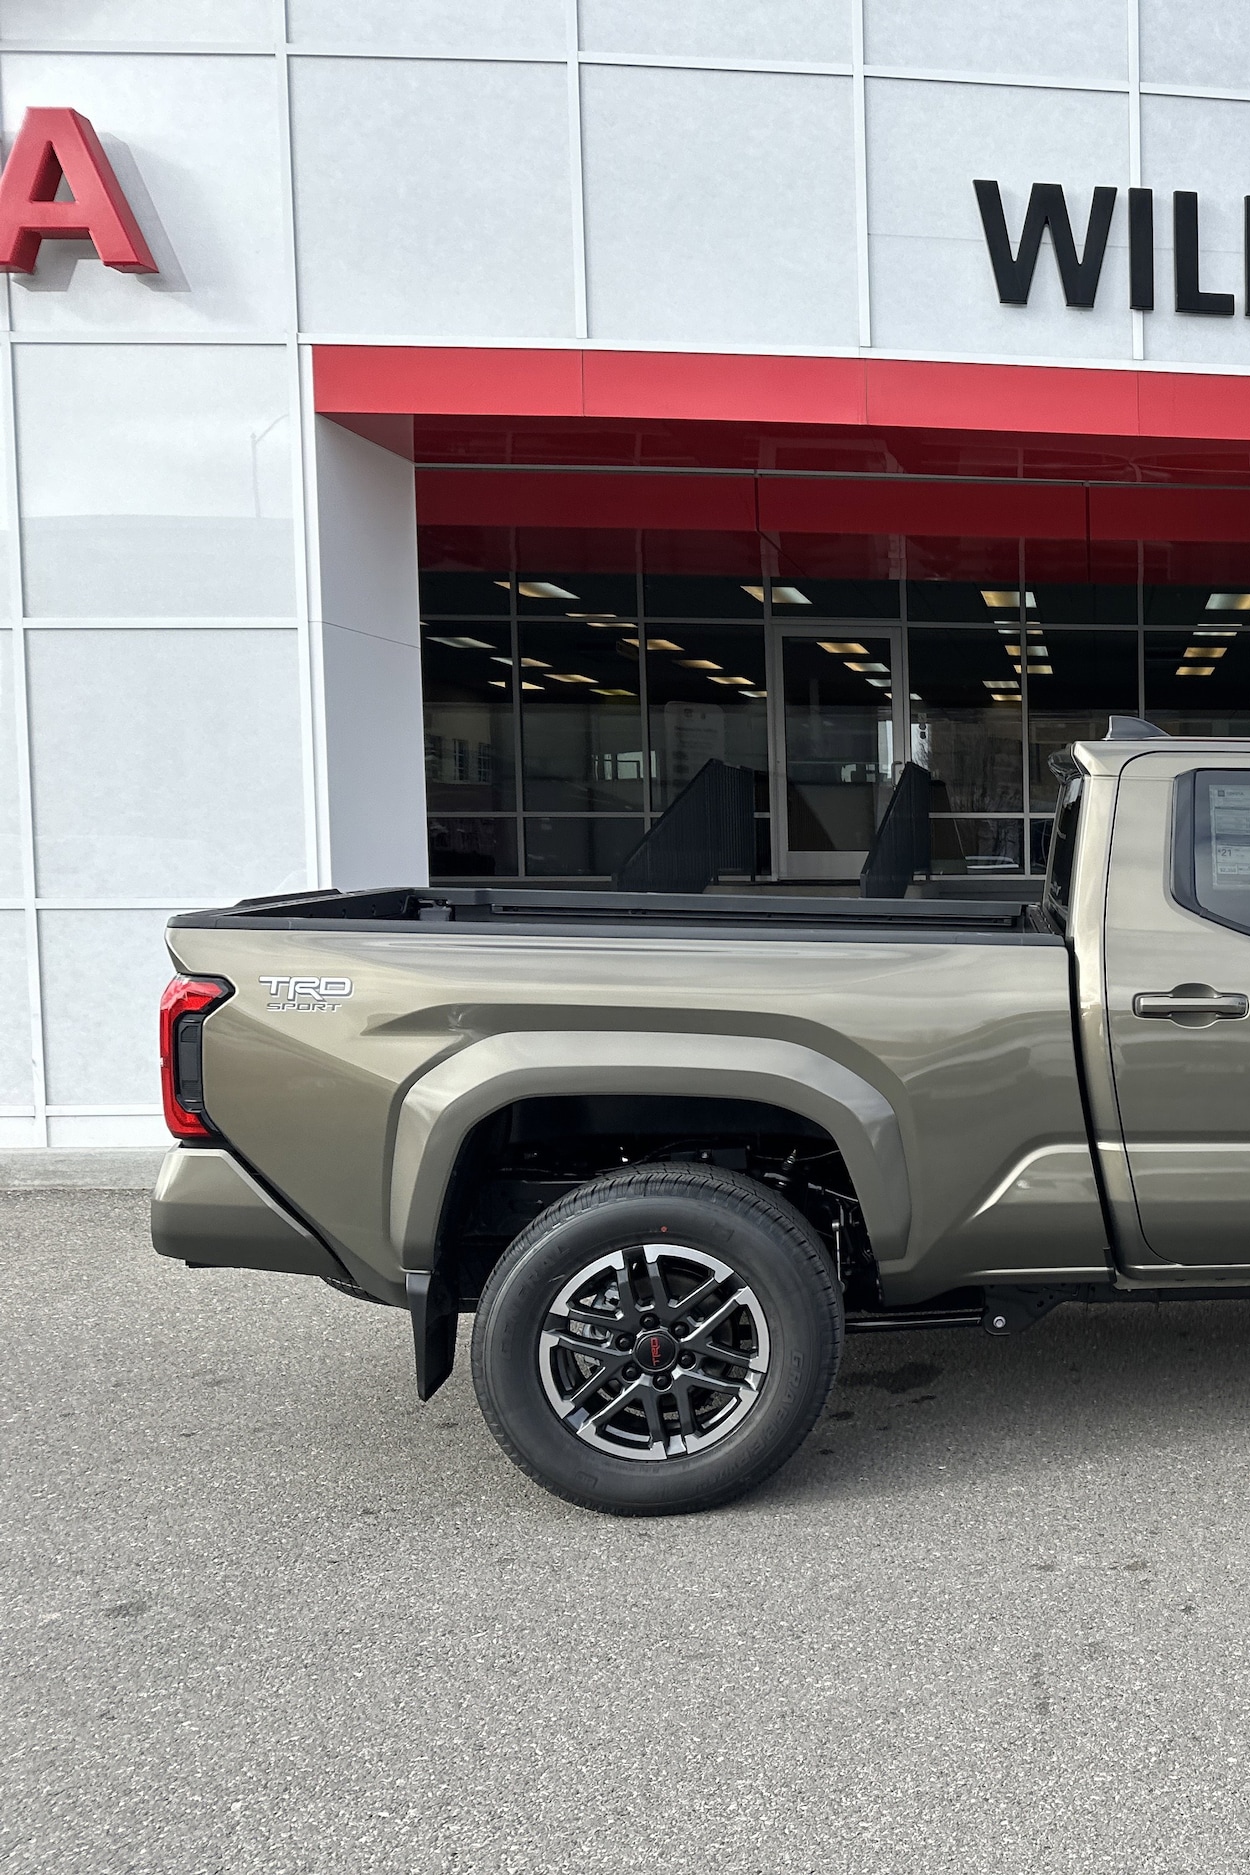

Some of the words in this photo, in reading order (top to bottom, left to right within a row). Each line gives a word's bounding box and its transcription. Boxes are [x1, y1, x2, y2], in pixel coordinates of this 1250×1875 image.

[0, 106, 159, 274] A
[1221, 849, 1232, 857] 21
[258, 975, 354, 1002] TRD
[266, 1002, 341, 1012] SPORT
[650, 1337, 661, 1366] TRD
